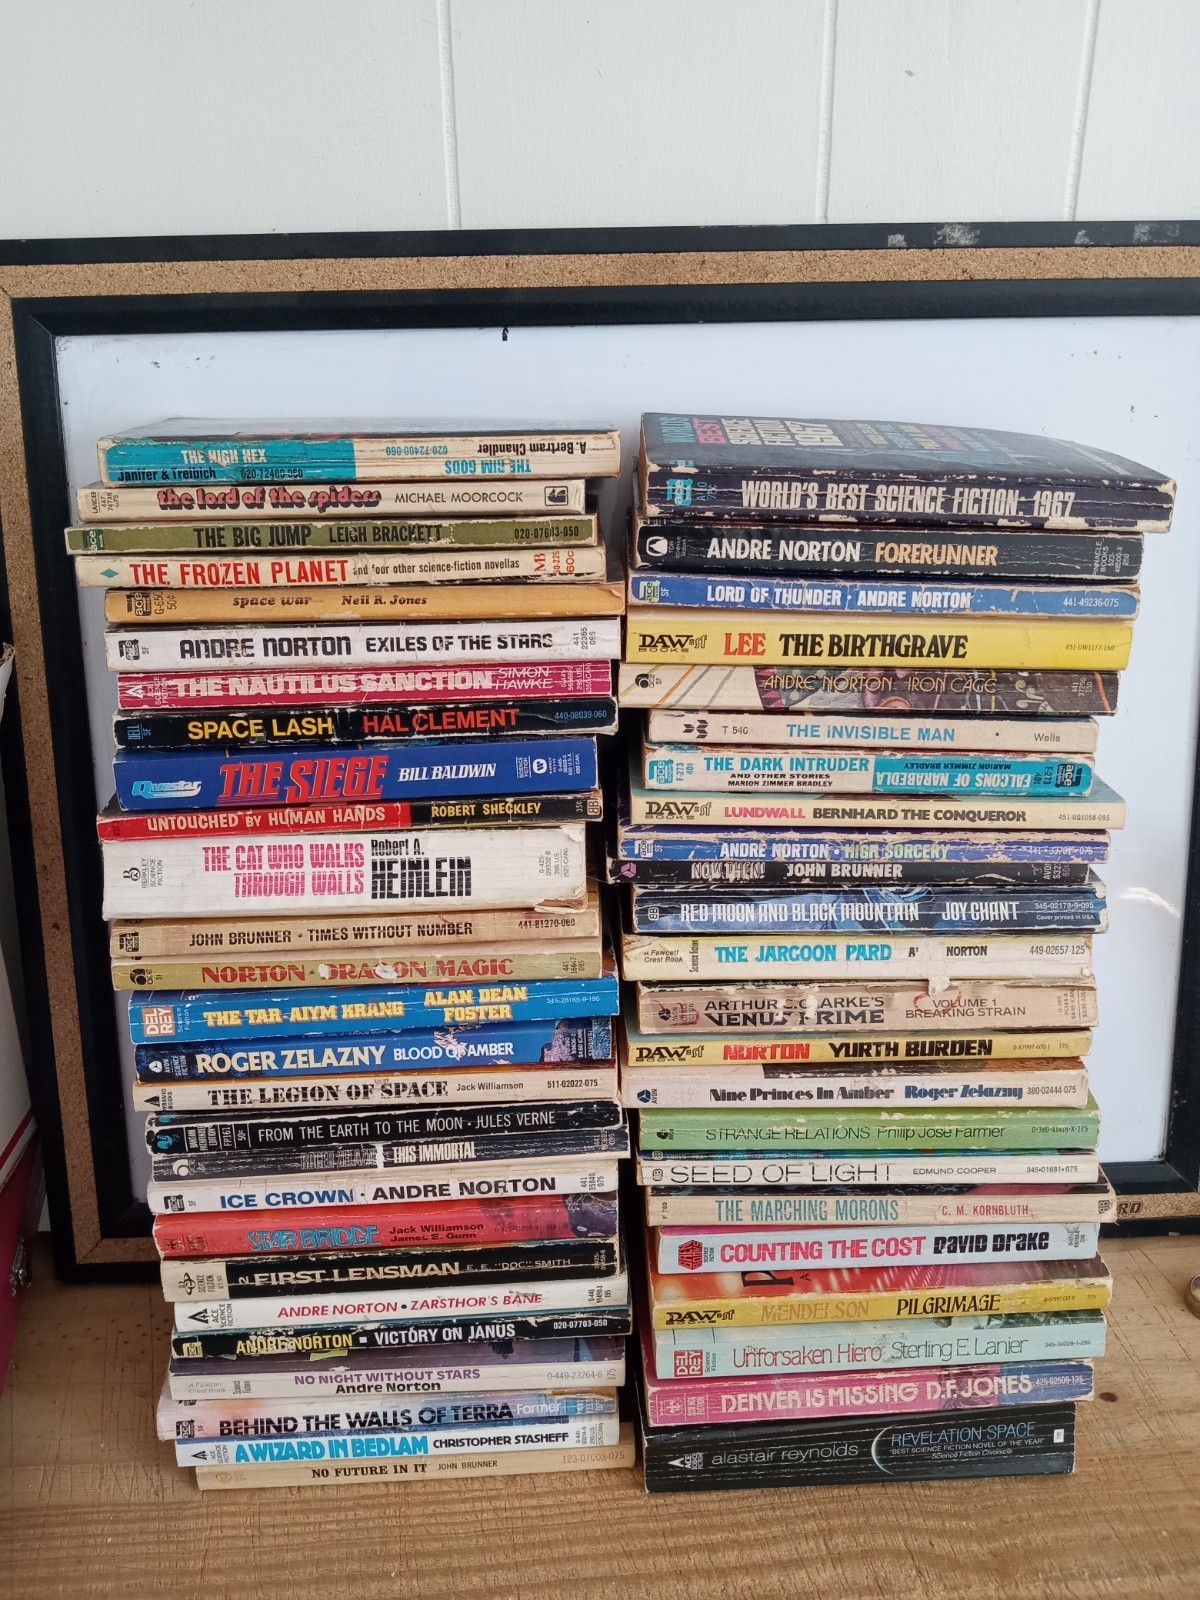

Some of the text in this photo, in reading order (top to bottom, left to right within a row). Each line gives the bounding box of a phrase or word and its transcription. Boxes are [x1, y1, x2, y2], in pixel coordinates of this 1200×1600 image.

[478, 442, 586, 455] A. Bertram Chandler
[445, 460, 476, 474] GODS
[509, 460, 531, 472] THE
[395, 492, 523, 503] MICHAEL MOORCOCK
[742, 480, 818, 508] WORLD'S
[826, 483, 868, 511] BEST
[875, 485, 946, 514] SCIENCE
[1033, 490, 1075, 517] 1967
[194, 526, 311, 547] THE BIG JUMP
[707, 538, 998, 564] ANDRE NORTON FORERUNNER
[130, 560, 348, 586] THE FROZEN PLANET
[372, 564, 389, 574] four
[393, 563, 415, 574] other
[419, 561, 481, 573] science-fiction
[484, 559, 520, 570] novellas
[707, 585, 841, 606] LORD OF THUNDER
[1063, 597, 1119, 607] 441-49236-075
[724, 633, 766, 656] LEE
[779, 634, 968, 657] THE BIRTHGRAVE
[363, 708, 520, 732] HAL CLEMENT
[555, 709, 607, 720] 440-08039-060
[188, 718, 333, 739] SPACE LASH
[787, 724, 820, 738] THE
[918, 727, 954, 741] MAN
[1034, 732, 1060, 742] Wells
[398, 763, 496, 782] BILL BALDWIN
[704, 758, 869, 771] THE DARK INTRUDER
[953, 774, 970, 786] OF
[975, 774, 1032, 788] FALCONS
[432, 803, 541, 817] ROBERT SHECKLEY
[725, 807, 805, 818] LUNDWALL
[813, 808, 1026, 822] BERNHARD THE CONQUEROR
[714, 944, 892, 963] THE JARGOON PARD
[424, 987, 528, 1006] ALAN DEAN
[444, 1004, 512, 1022] FOSTER
[906, 1007, 1025, 1018] BREAKING STRAIN
[828, 1040, 993, 1057] YURTH BURDEN
[196, 1045, 386, 1073] ROGER ZELAZNY
[457, 1082, 523, 1091] Jack Williamson
[547, 1079, 598, 1088] 511-02022-075
[710, 1086, 894, 1102] Nine Princes In Amber
[905, 1085, 1023, 1100] Roger Zelazny
[475, 1111, 555, 1129] JULES VERNE
[259, 1116, 462, 1142] FROM THE EARTH TO THE MOON
[372, 1177, 556, 1200] ANDRE NORTON
[220, 1190, 353, 1208] ICE CROWN
[716, 1199, 898, 1221] THE MARCHING MORONS
[942, 1205, 1029, 1215] C. M. KORNBLUTH
[720, 1236, 926, 1262] COUNTING THE COST
[278, 1302, 398, 1318] ANDRE NORTON
[411, 1294, 542, 1311] ZARSTHOR'S BANE
[896, 1294, 999, 1315] PILGRIMAGE
[553, 1319, 607, 1329] 020-07703-050
[374, 1324, 515, 1345] VICTORY ON JANUS
[892, 1341, 953, 1360] Sterling
[975, 1337, 1029, 1354] Lanier
[294, 1369, 480, 1385] NO NIGHT WITHOUT STARS
[336, 1381, 441, 1394] Andre Norton
[927, 1375, 1033, 1398] D.F. JONES
[516, 1403, 562, 1415] Farmer
[433, 1432, 569, 1448] CHRISTOPHER STASHEFF
[891, 1422, 1035, 1446] REVELATION SPACE
[235, 1435, 428, 1462] A WIZARD IN BEDLAM
[712, 1444, 859, 1465] alastair reynolds
[312, 1463, 427, 1479] NO FUTURE IN IT
[438, 1460, 497, 1470] JOHN BRUNNER
